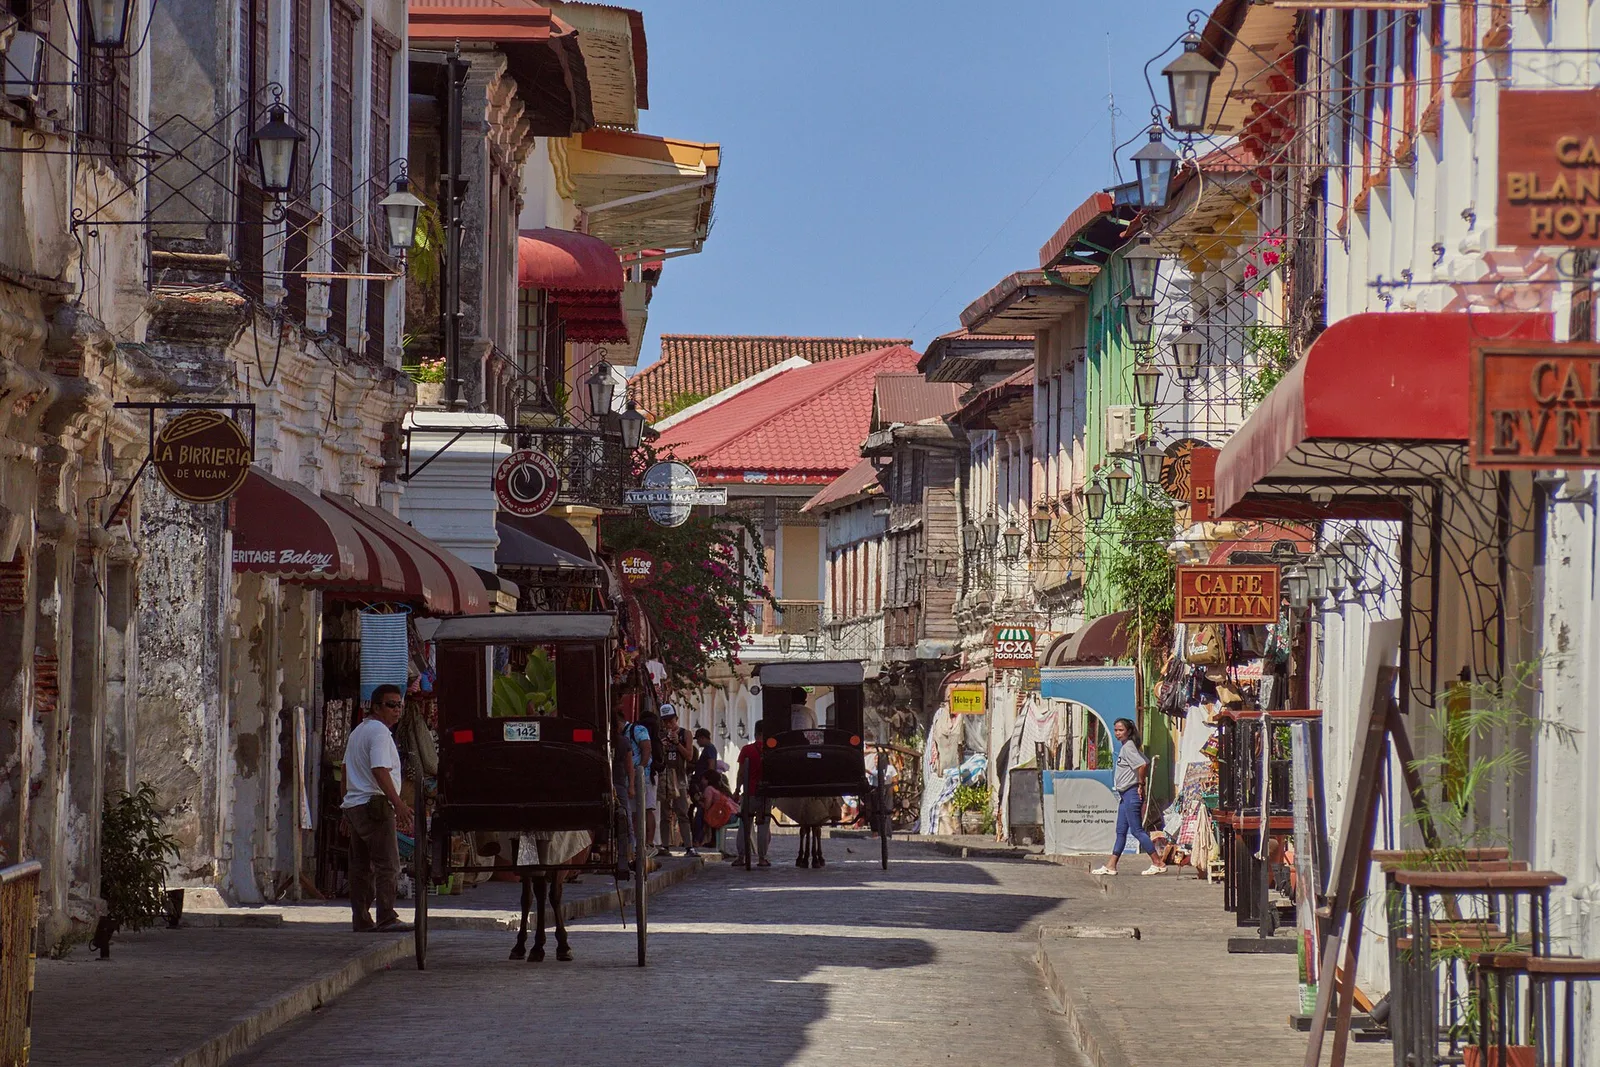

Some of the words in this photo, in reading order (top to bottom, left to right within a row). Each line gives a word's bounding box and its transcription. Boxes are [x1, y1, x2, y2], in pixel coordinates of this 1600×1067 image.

[1530, 206, 1600, 236] HOT
[154, 444, 173, 462] LA
[179, 445, 251, 467] BIRRIERIA
[177, 469, 189, 478] DE
[194, 469, 226, 479] VIGAN
[498, 453, 525, 480] CAFE
[232, 550, 276, 563] ERITAGE
[279, 549, 333, 570] Bakery
[621, 557, 652, 567] coffee
[623, 566, 650, 574] break
[1194, 573, 1262, 595] CAFE
[1183, 595, 1273, 616] EVELYN
[995, 641, 1033, 653] JCXA
[516, 727, 537, 737] 142
